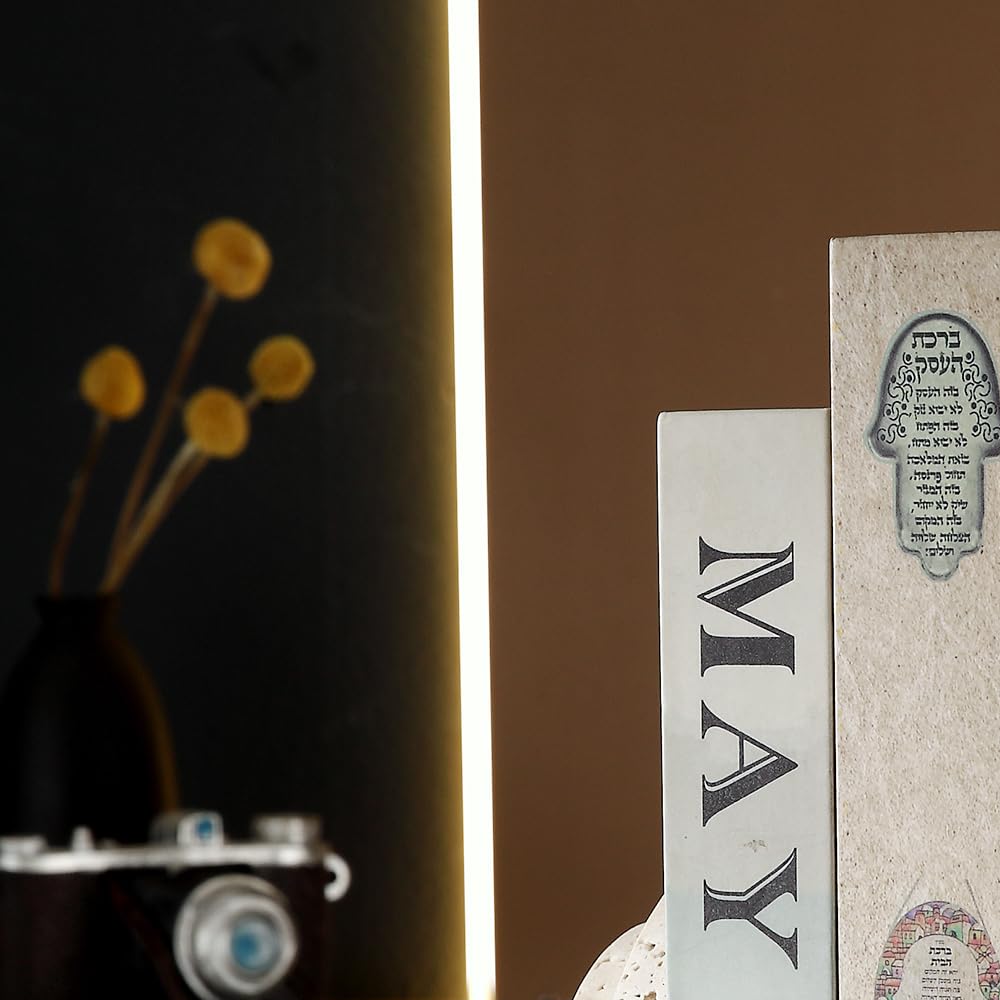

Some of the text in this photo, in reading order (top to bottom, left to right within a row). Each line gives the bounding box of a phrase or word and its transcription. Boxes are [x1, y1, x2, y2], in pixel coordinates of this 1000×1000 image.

[912, 331, 961, 348] ברכת
[914, 351, 963, 384] העסק
[697, 535, 799, 970] MAY
